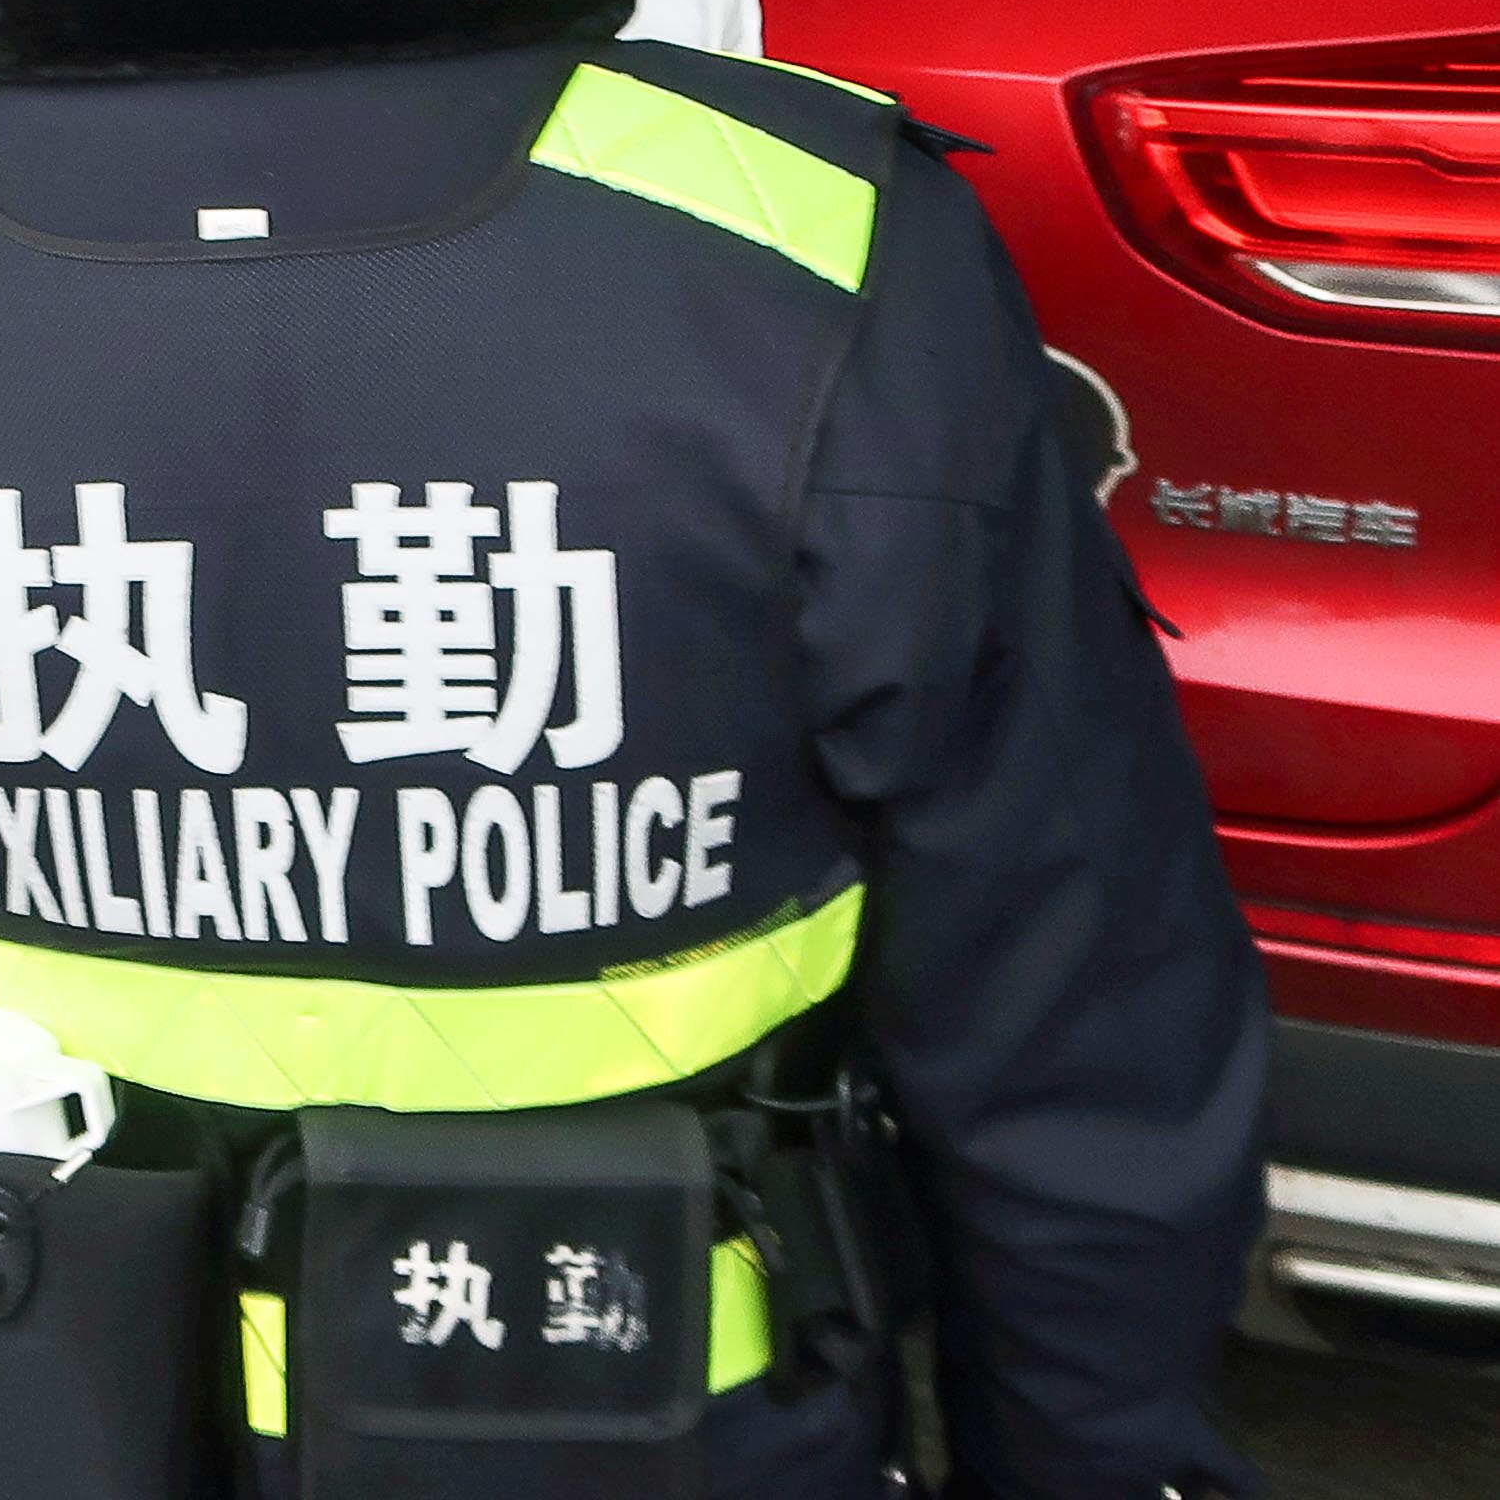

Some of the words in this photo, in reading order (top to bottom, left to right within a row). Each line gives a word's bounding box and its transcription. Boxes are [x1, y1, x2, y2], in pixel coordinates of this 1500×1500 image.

[1151, 476, 1421, 547] 长城汽车
[396, 768, 744, 947] POLICE
